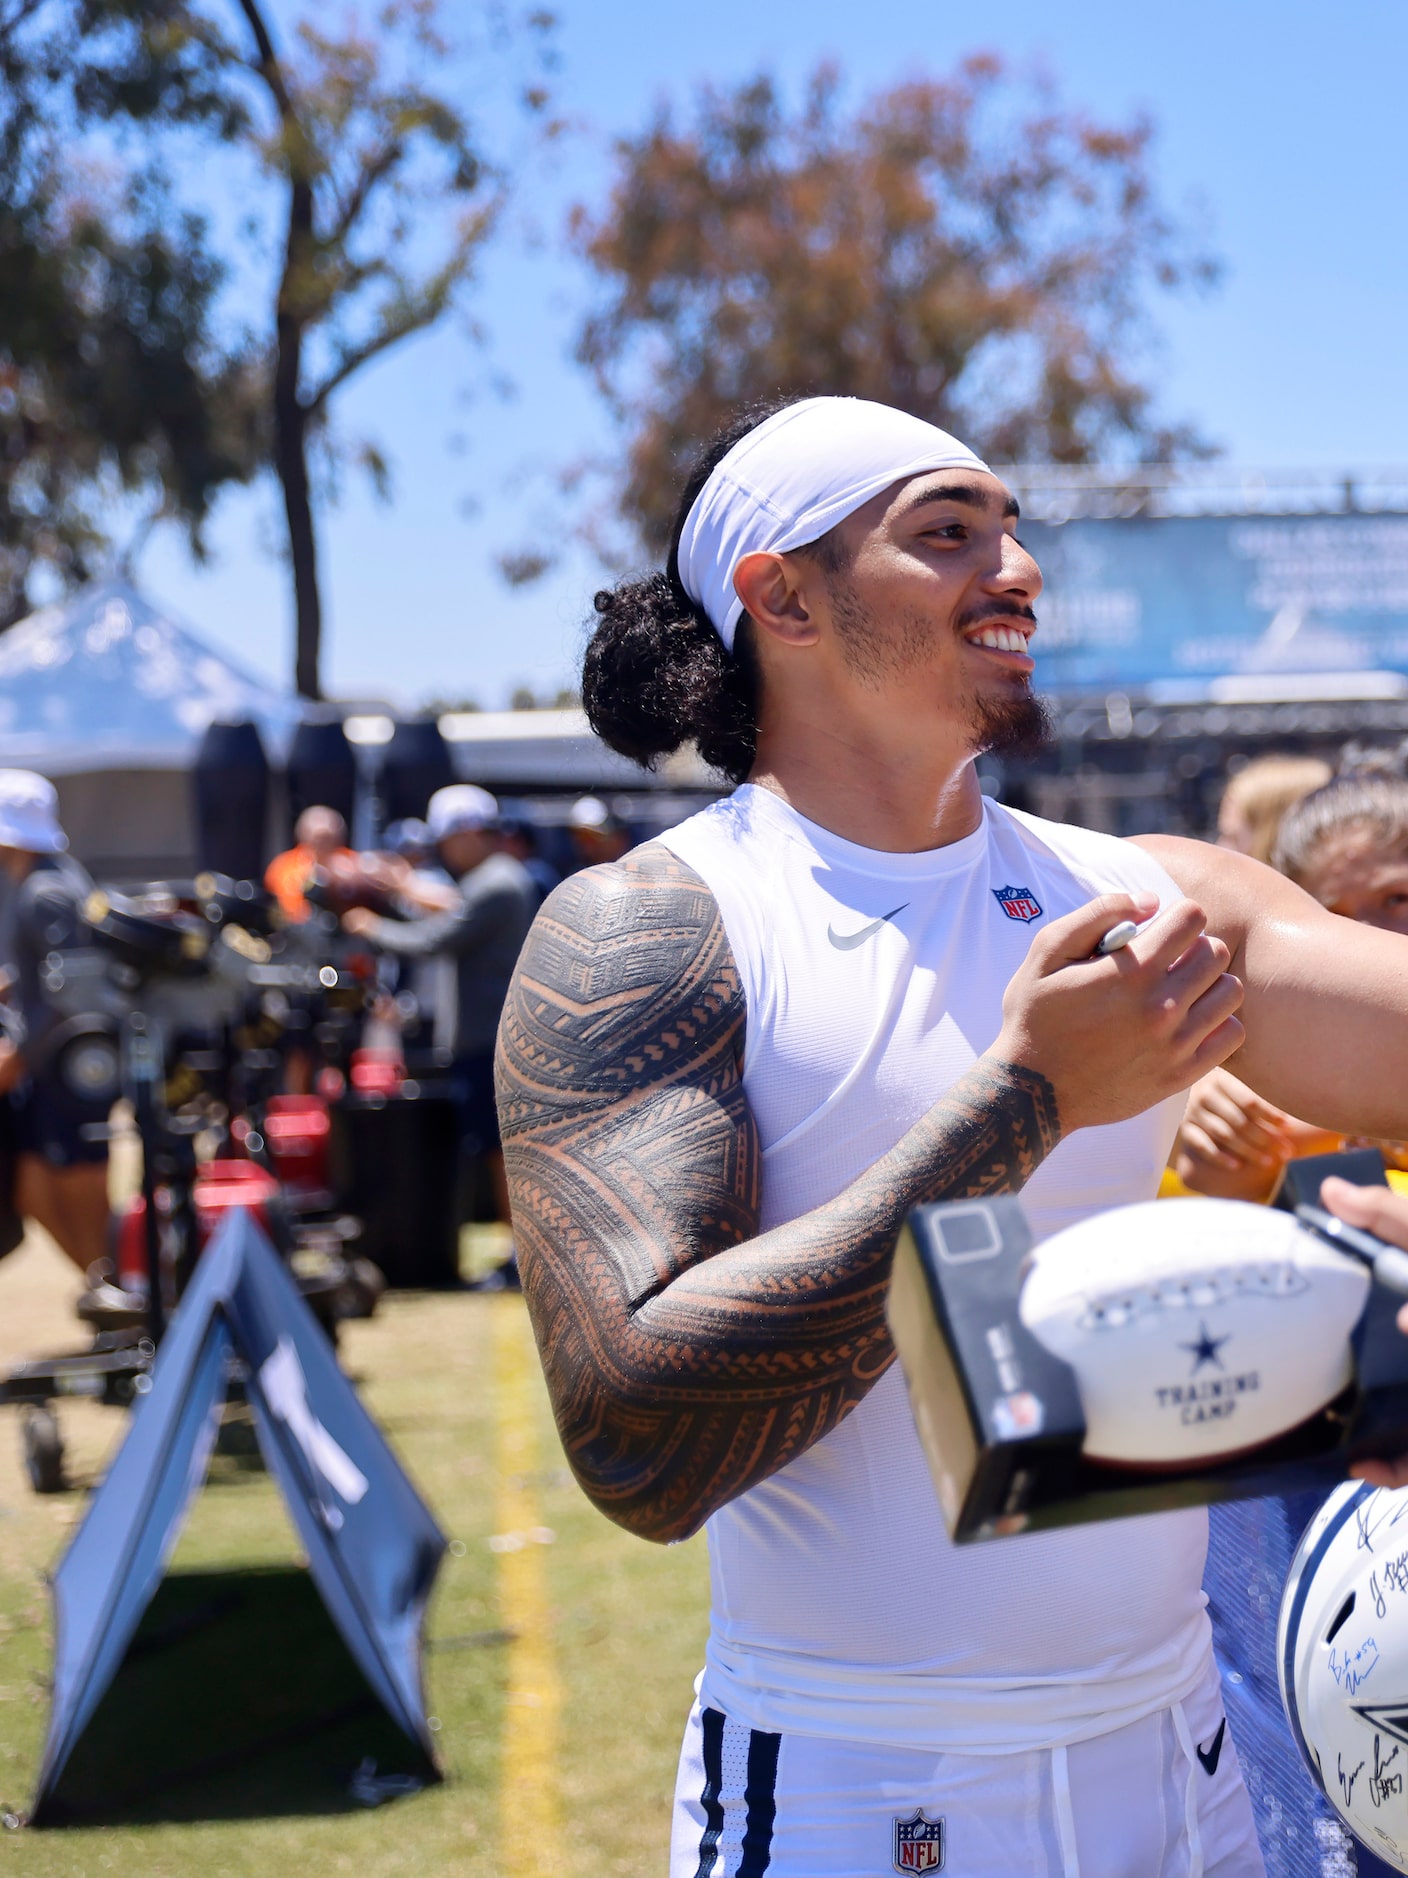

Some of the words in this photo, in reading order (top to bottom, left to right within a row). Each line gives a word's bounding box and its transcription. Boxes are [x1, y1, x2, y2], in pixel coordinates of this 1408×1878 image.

[1002, 899, 1040, 919] NFL
[1155, 1370, 1260, 1408] TRAINING
[1181, 1399, 1236, 1426] CAMP
[901, 1842, 938, 1869] NFL
